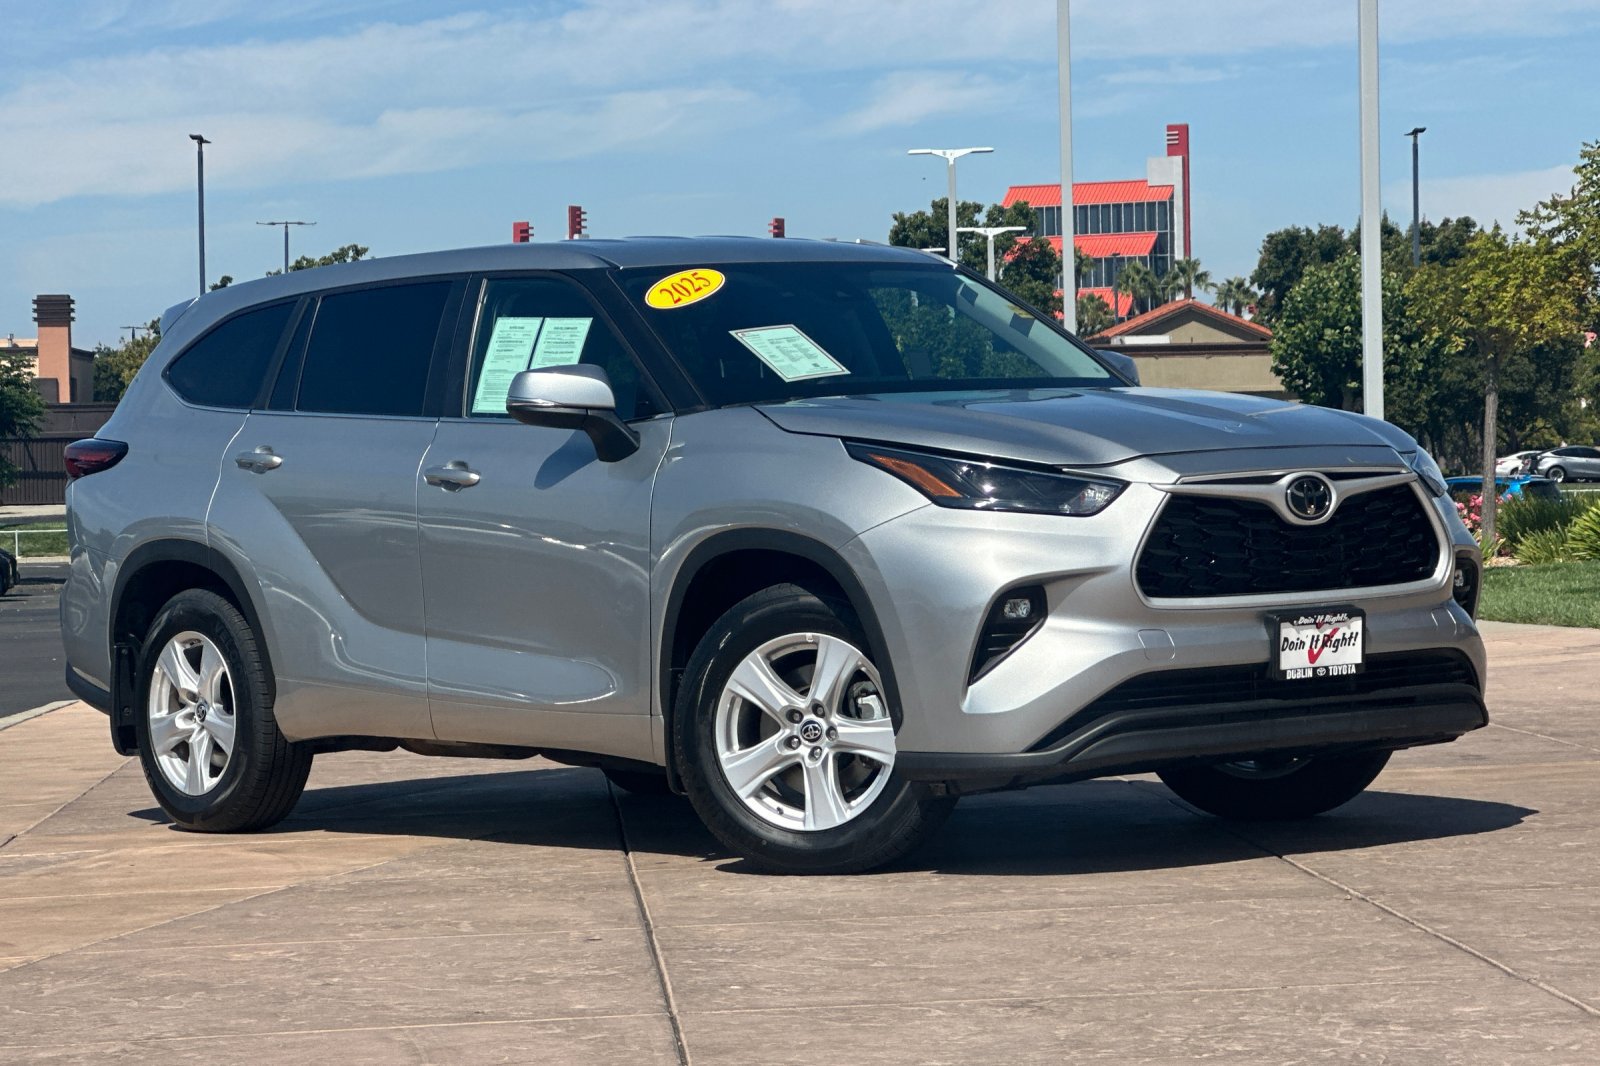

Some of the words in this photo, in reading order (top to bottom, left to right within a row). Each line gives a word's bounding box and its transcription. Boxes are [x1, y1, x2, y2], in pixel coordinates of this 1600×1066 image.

[659, 272, 711, 304] 2025
[1281, 634, 1308, 652] Doin'
[1310, 635, 1320, 649] It
[1322, 632, 1358, 653] Right!
[1286, 667, 1313, 680] DUBLIN
[1328, 664, 1356, 676] TOYOTA
